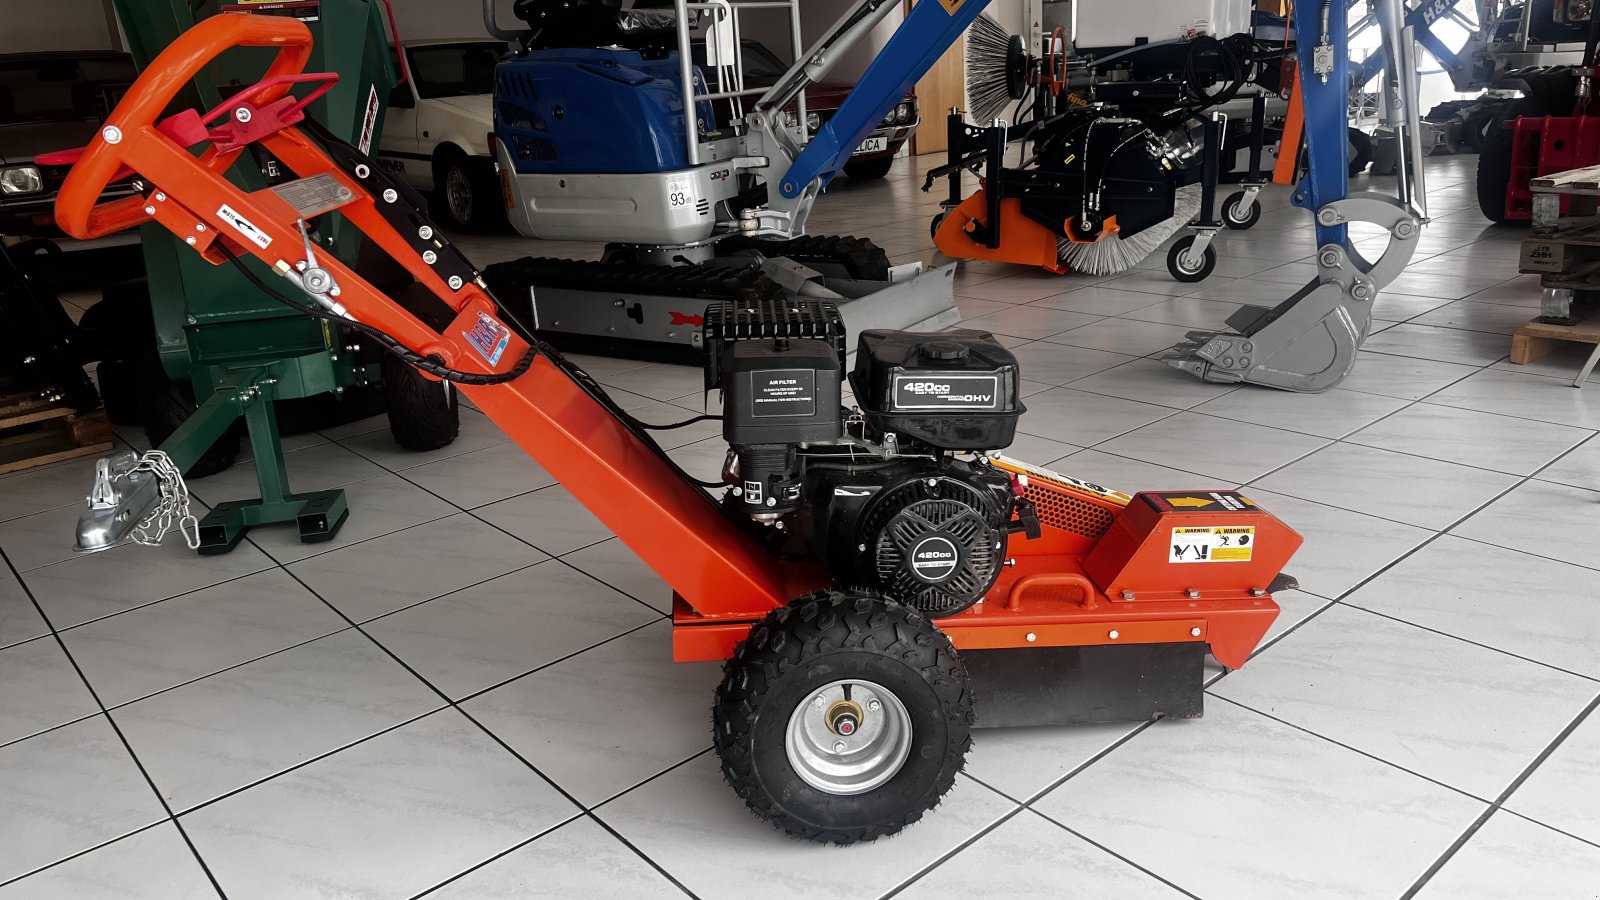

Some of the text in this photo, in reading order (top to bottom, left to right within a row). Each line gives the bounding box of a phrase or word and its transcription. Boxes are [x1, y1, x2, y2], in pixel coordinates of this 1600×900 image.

[670, 192, 685, 206] 93
[221, 208, 236, 220] SLOW
[903, 382, 951, 392] 420cc
[964, 394, 992, 402] OHV
[917, 551, 952, 559] 420cc
